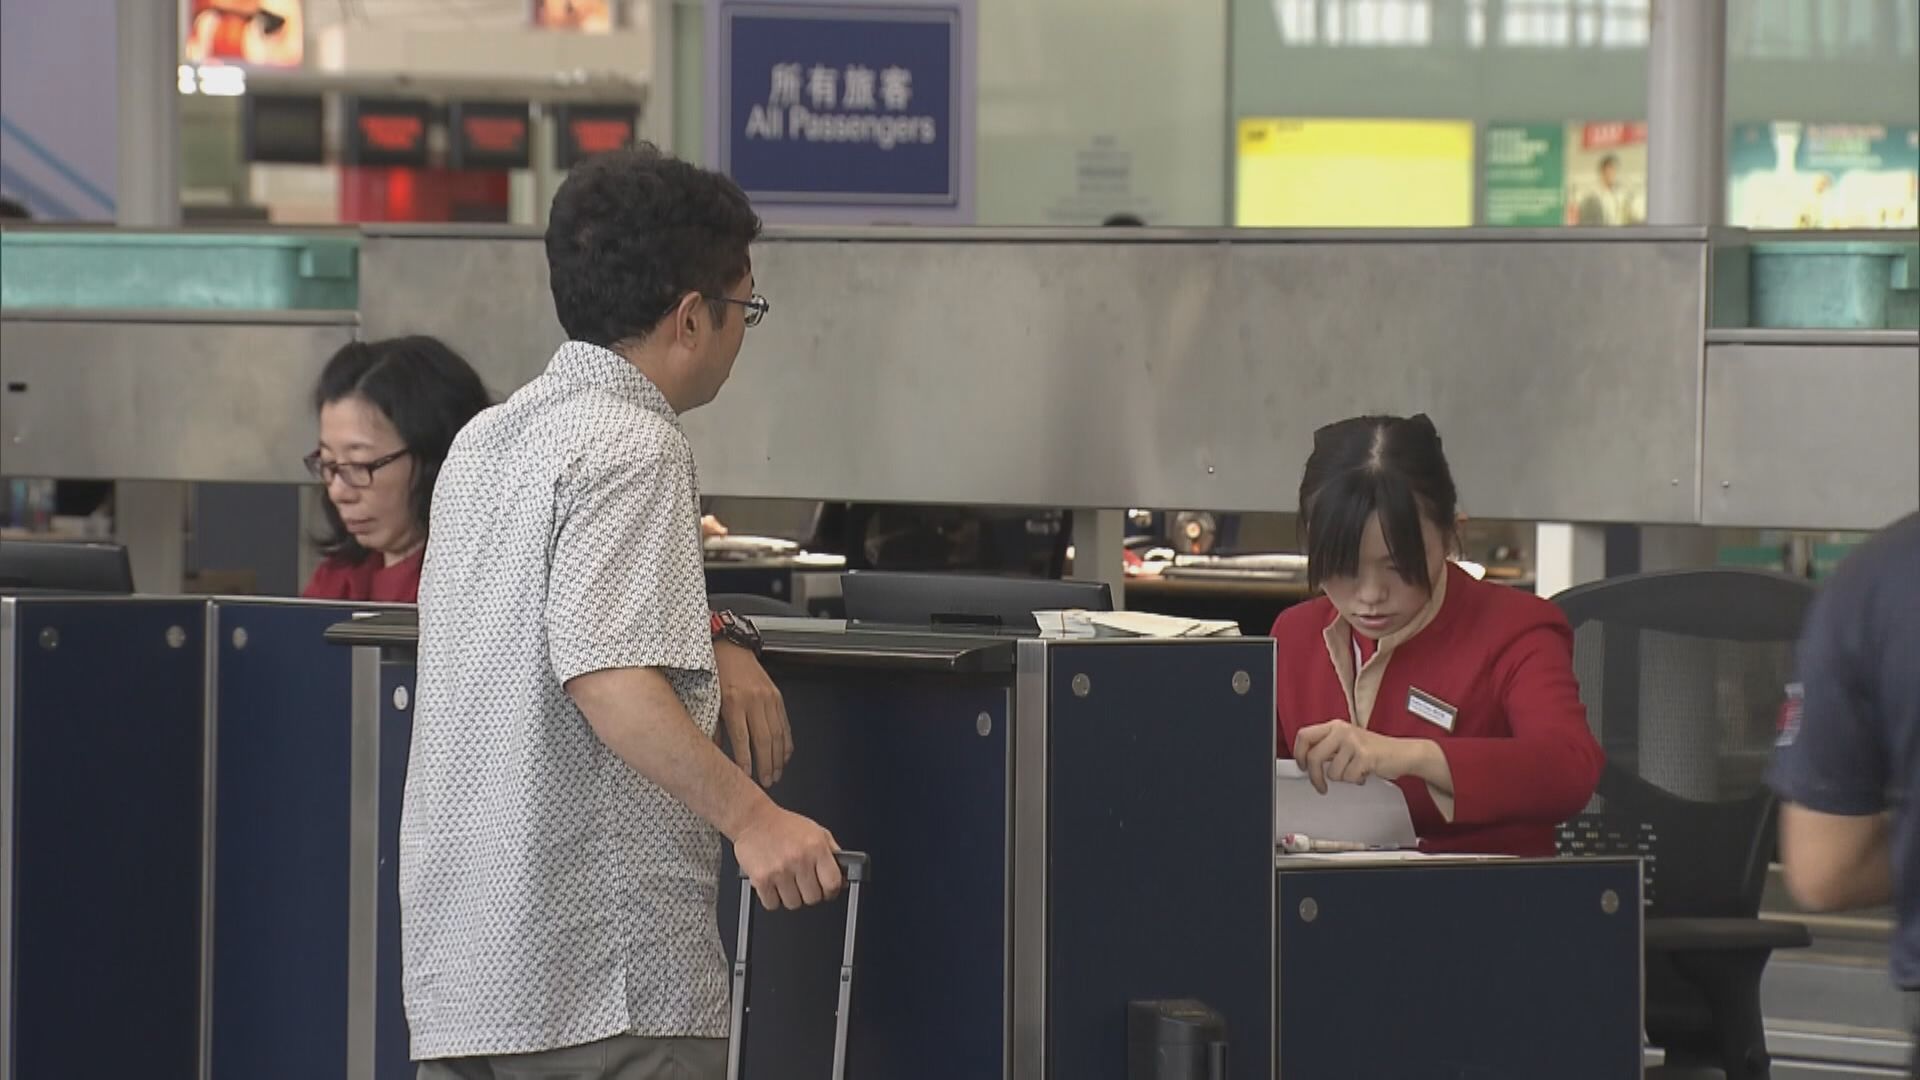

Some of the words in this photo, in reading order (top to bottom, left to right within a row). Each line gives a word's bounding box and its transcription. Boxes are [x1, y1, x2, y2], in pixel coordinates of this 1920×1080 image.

[769, 63, 912, 109] 所有旅客
[746, 103, 783, 139] All
[788, 104, 936, 149] Passengers
